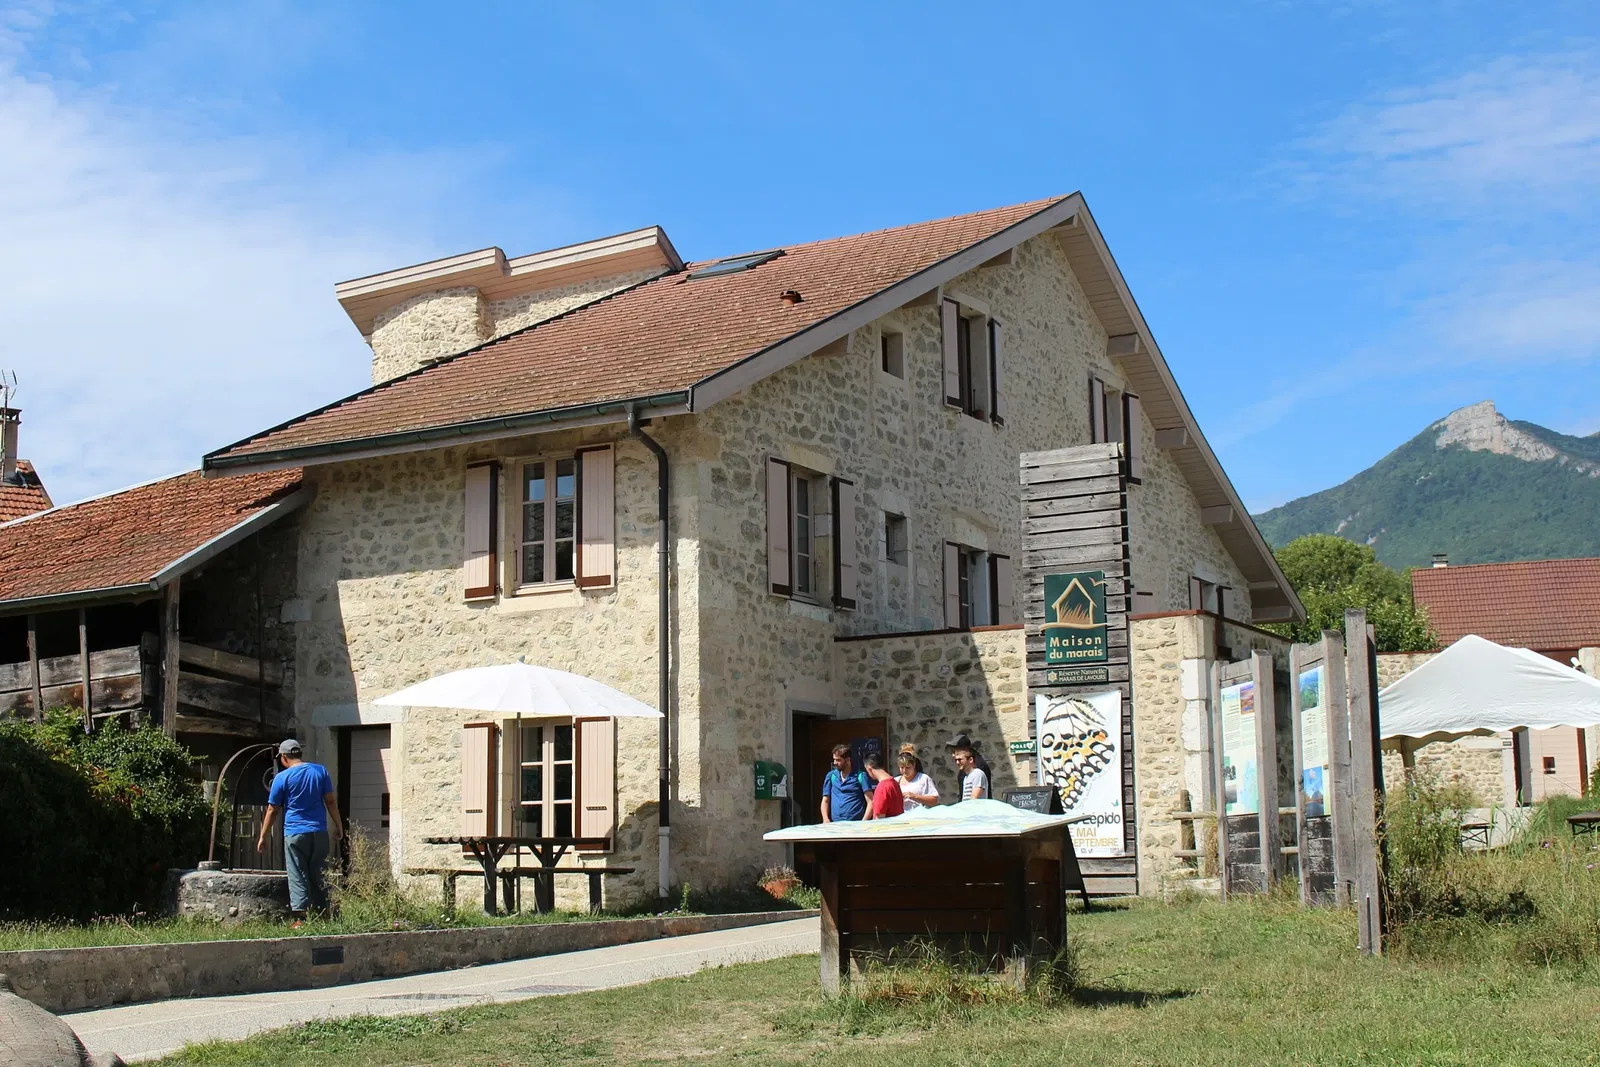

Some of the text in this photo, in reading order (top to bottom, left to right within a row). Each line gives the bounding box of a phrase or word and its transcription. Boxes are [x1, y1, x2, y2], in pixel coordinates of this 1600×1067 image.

[1050, 635, 1102, 648] Maison
[1049, 646, 1103, 659] du marais
[1081, 668, 1106, 676] Naturelle
[1083, 811, 1121, 828] Lépido
[1076, 827, 1097, 838] MAI
[1073, 837, 1119, 848] EPTEMBRE
